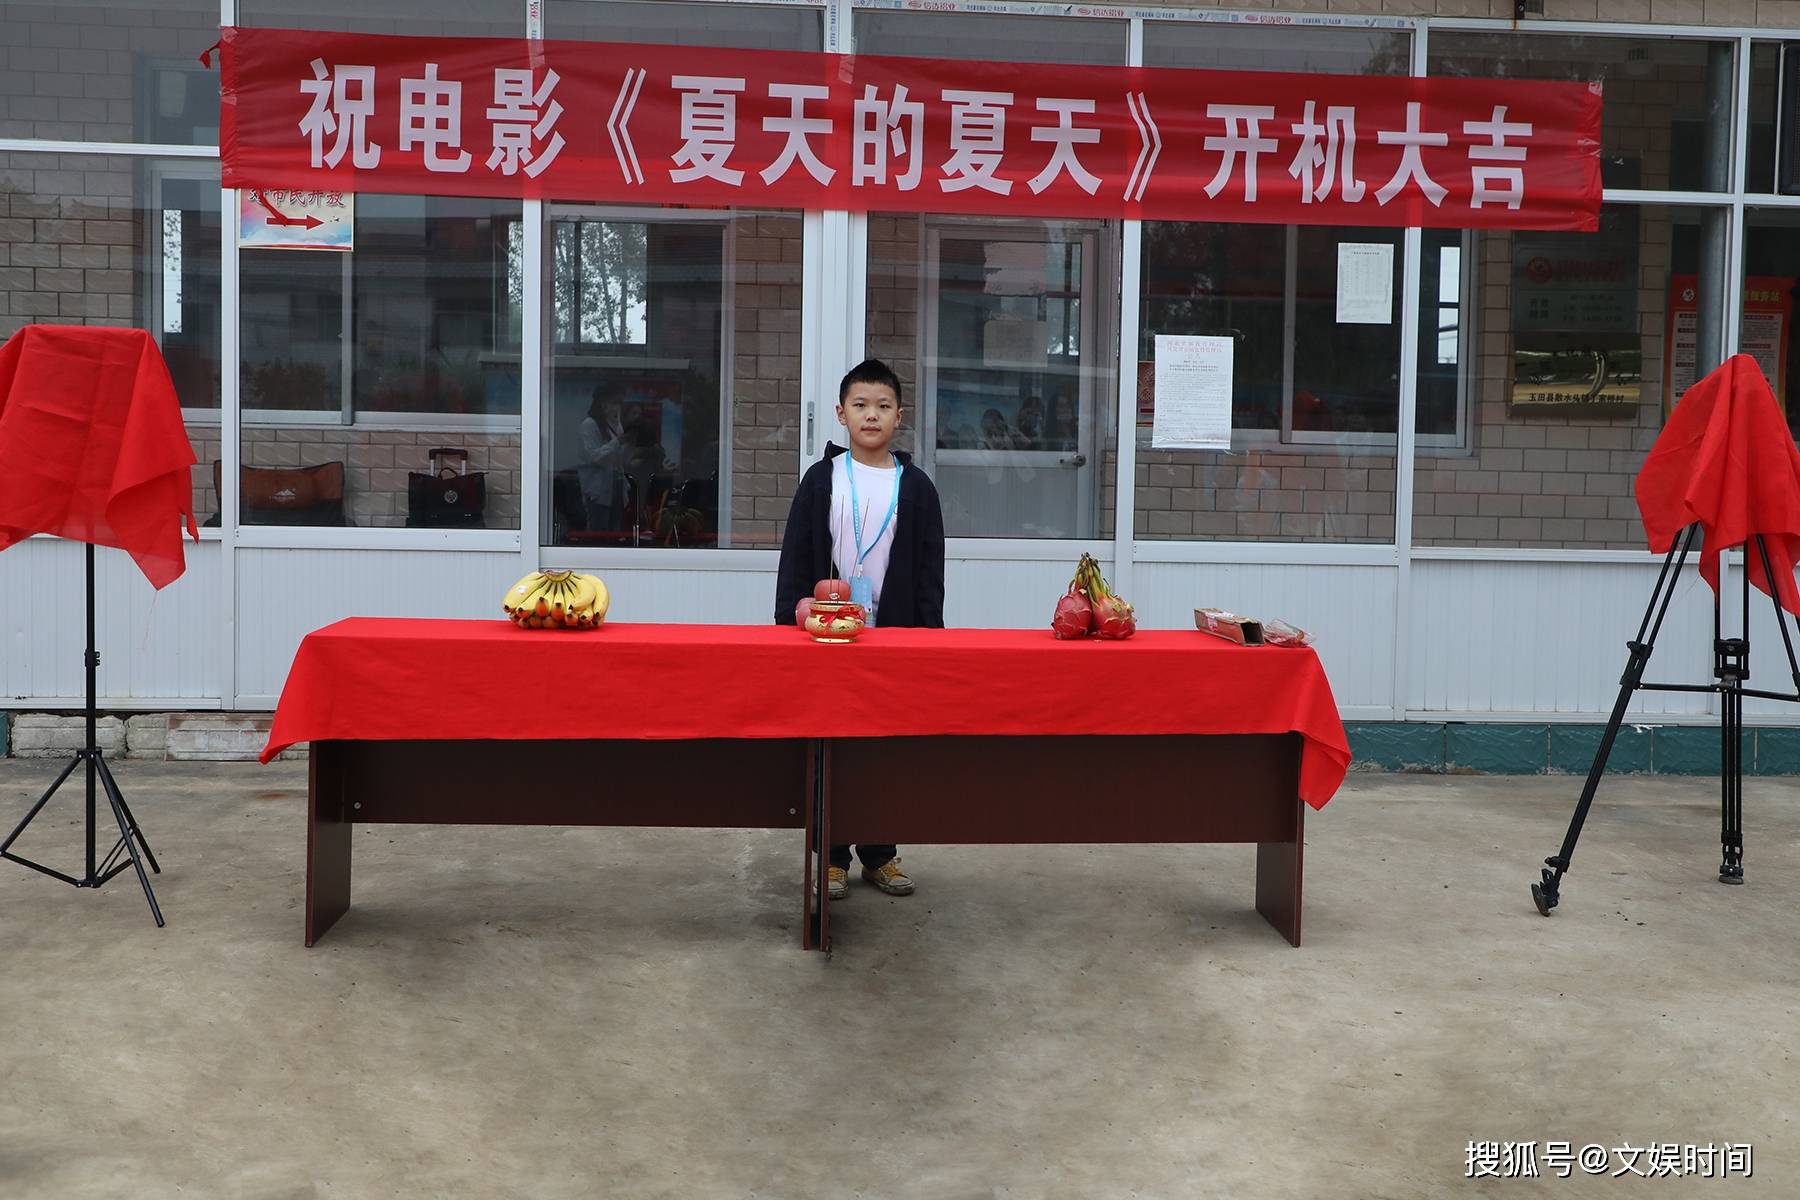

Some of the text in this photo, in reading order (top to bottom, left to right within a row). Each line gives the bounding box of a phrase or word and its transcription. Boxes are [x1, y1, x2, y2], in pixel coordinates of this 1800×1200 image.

[299, 58, 1533, 210] 祝电影《夏天的夏天》开机大吉
